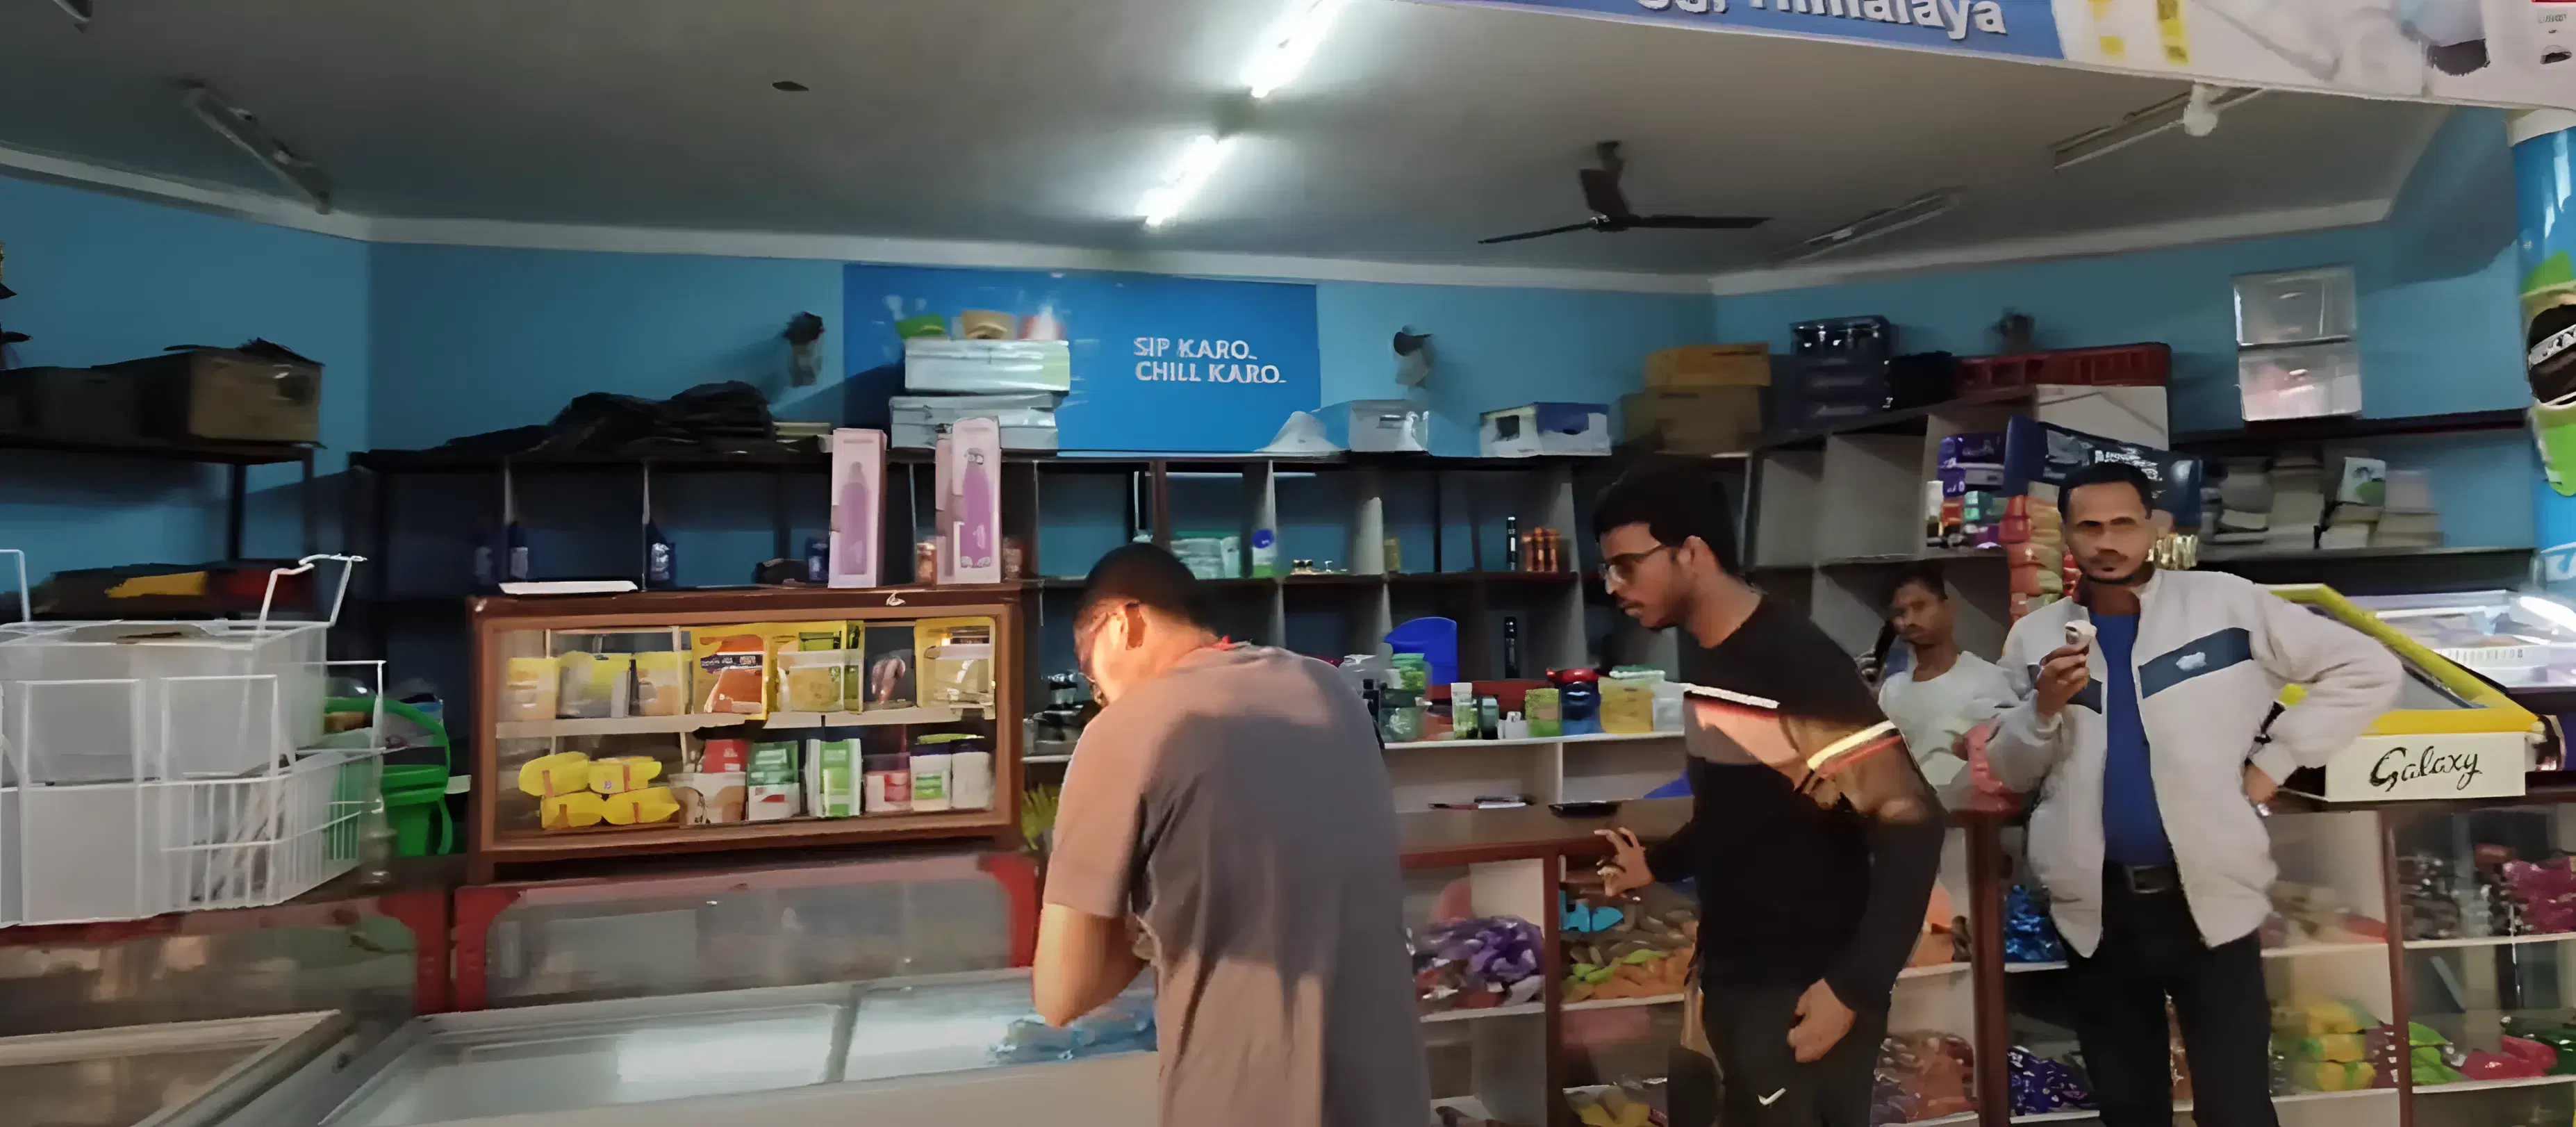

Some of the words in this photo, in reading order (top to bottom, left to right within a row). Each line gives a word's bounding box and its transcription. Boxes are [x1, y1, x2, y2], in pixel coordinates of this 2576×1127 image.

[1750, 0, 2006, 40] alaya
[1133, 336, 1171, 357] SIP
[1135, 361, 1202, 381] CHILL
[2369, 745, 2483, 793] Galaxy
